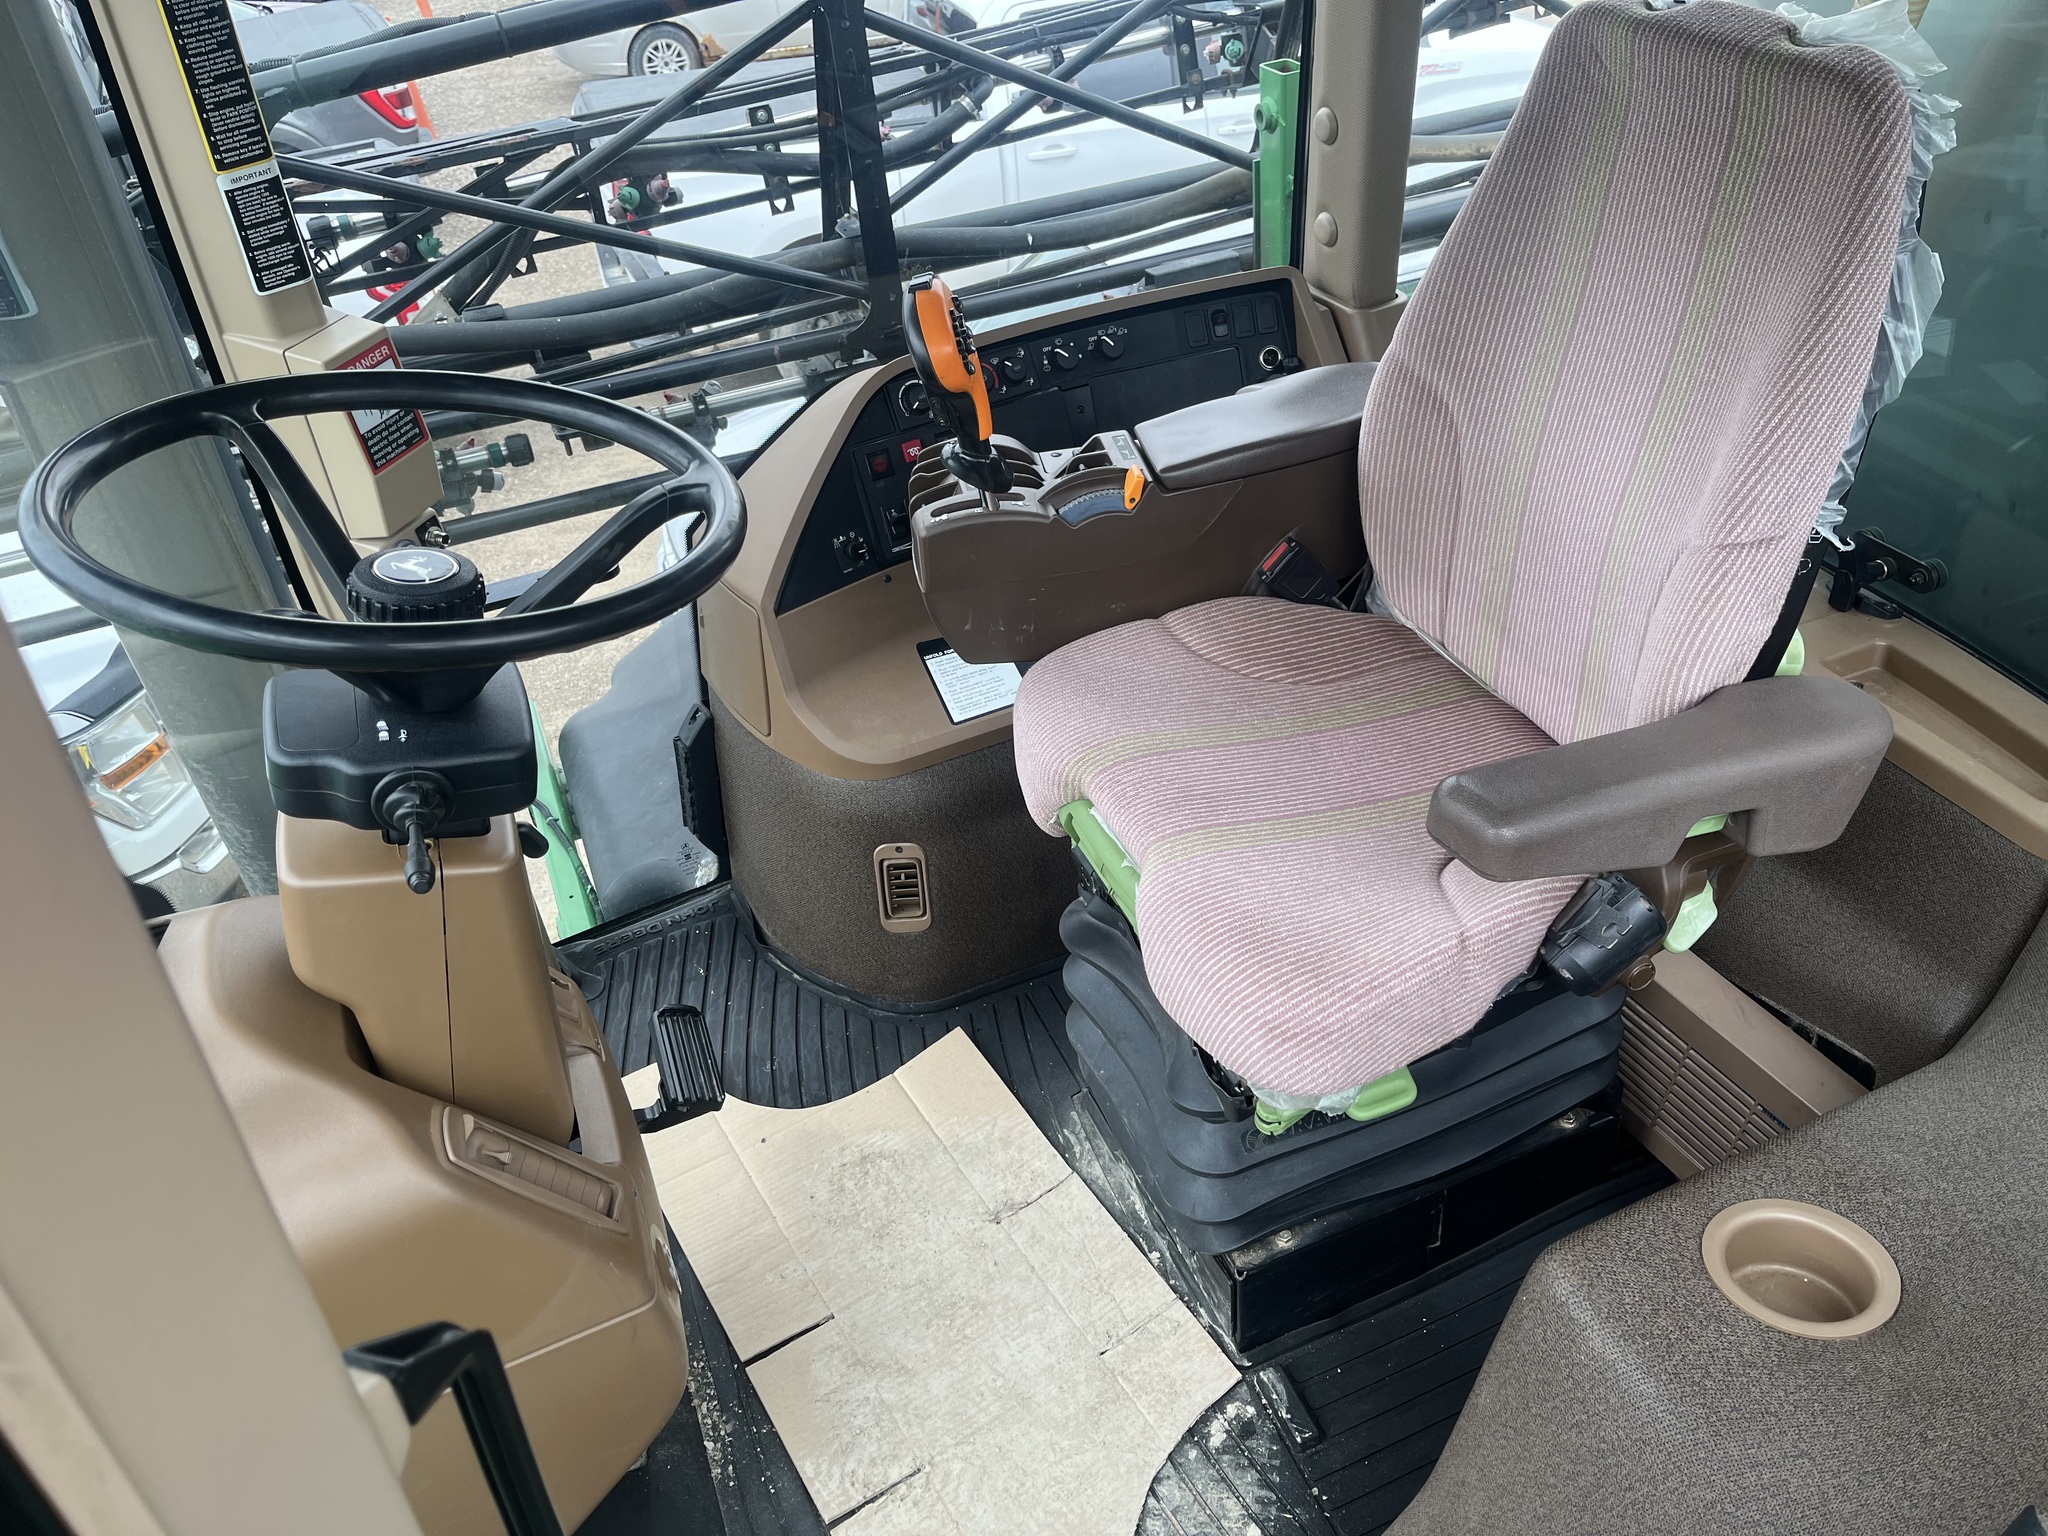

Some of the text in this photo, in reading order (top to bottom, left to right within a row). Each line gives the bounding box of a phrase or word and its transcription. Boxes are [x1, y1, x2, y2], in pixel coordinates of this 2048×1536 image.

[183, 12, 206, 20] operation.
[215, 54, 236, 63] operating
[210, 69, 226, 77] ground
[219, 91, 241, 101] prohibited
[228, 118, 255, 128] dismounting.
[239, 124, 260, 133] movement
[220, 142, 240, 150] servicing
[230, 168, 271, 184] IMPORTANT
[368, 435, 382, 446] death
[389, 424, 397, 432] not
[397, 413, 414, 427] contact
[372, 423, 385, 434] avoid
[385, 414, 399, 426] injury
[371, 439, 388, 453] electric
[388, 432, 400, 441] lines
[400, 423, 413, 433] when
[374, 446, 392, 460] moving
[398, 428, 419, 444] operating
[376, 445, 407, 467] this machine.
[593, 900, 720, 955] JOHN DEERE
